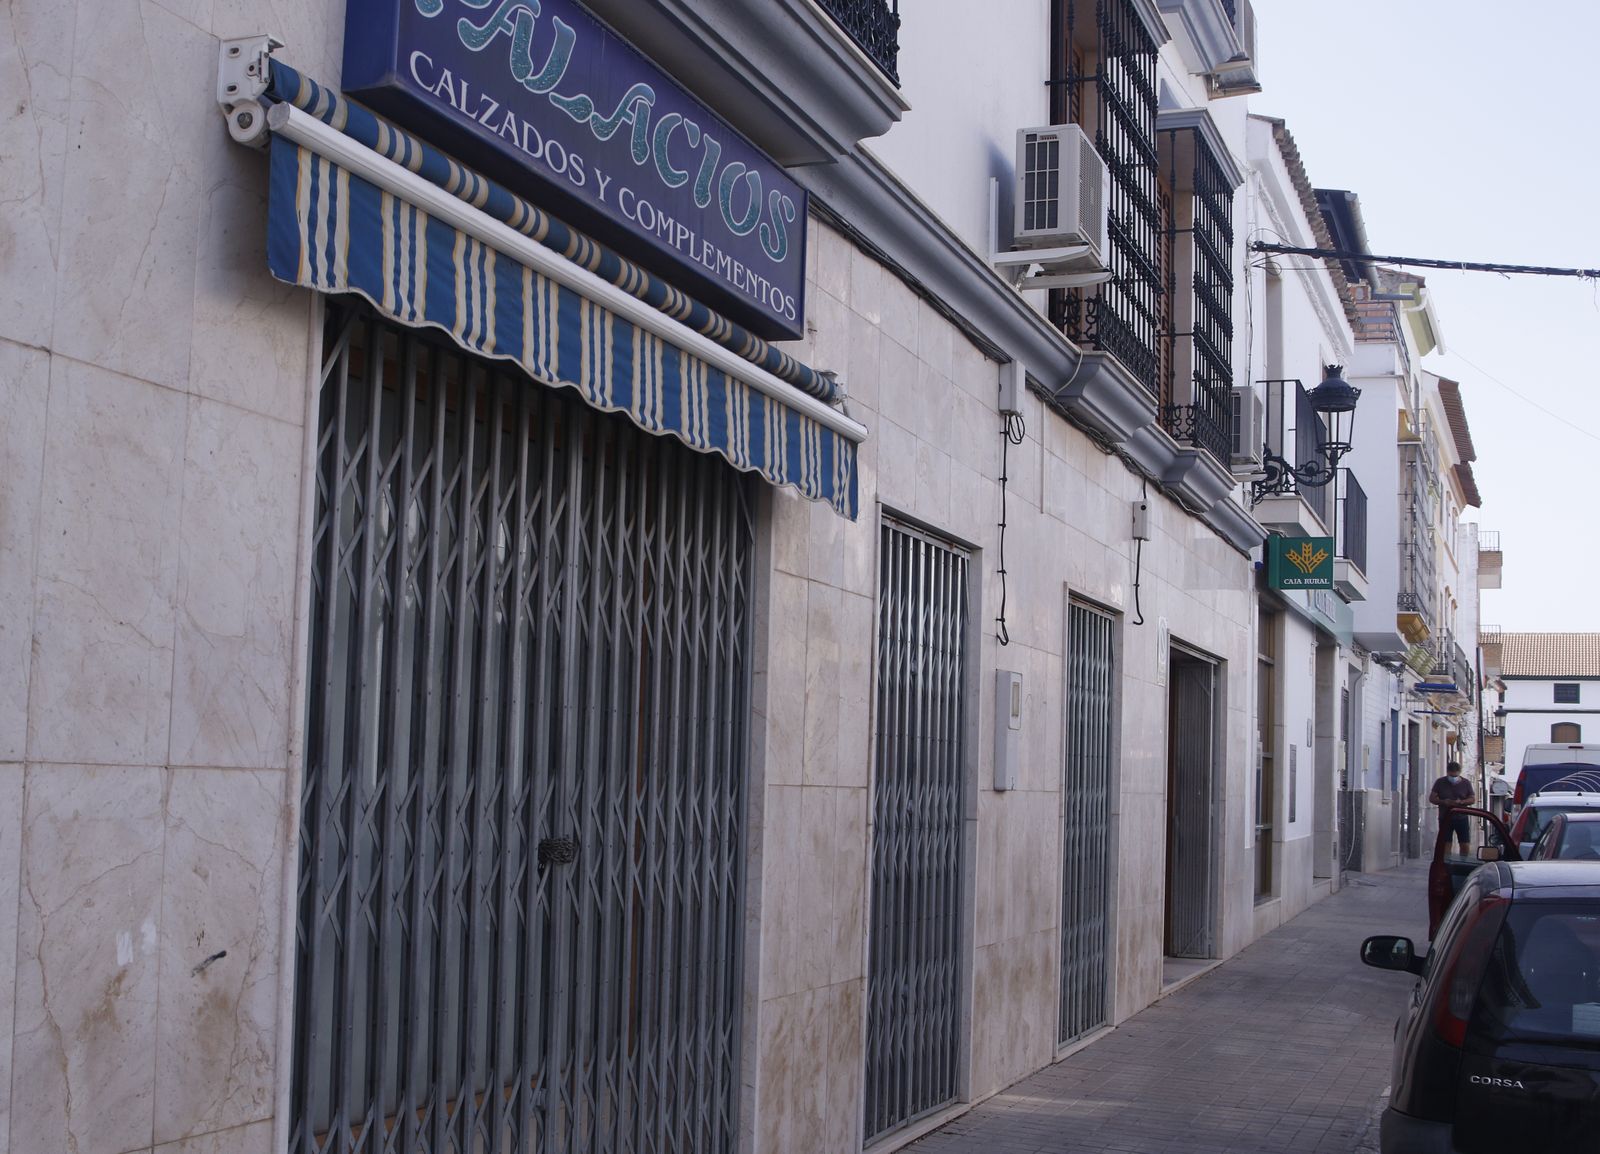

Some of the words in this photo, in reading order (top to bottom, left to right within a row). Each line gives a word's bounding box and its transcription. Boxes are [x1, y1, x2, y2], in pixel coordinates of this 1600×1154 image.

[409, 50, 586, 187] CALZADOS
[594, 168, 612, 202] Y
[618, 187, 796, 321] COMPLEMENTOS
[413, 0, 796, 262] ALACIOS
[1470, 1075, 1524, 1089] CORSA
